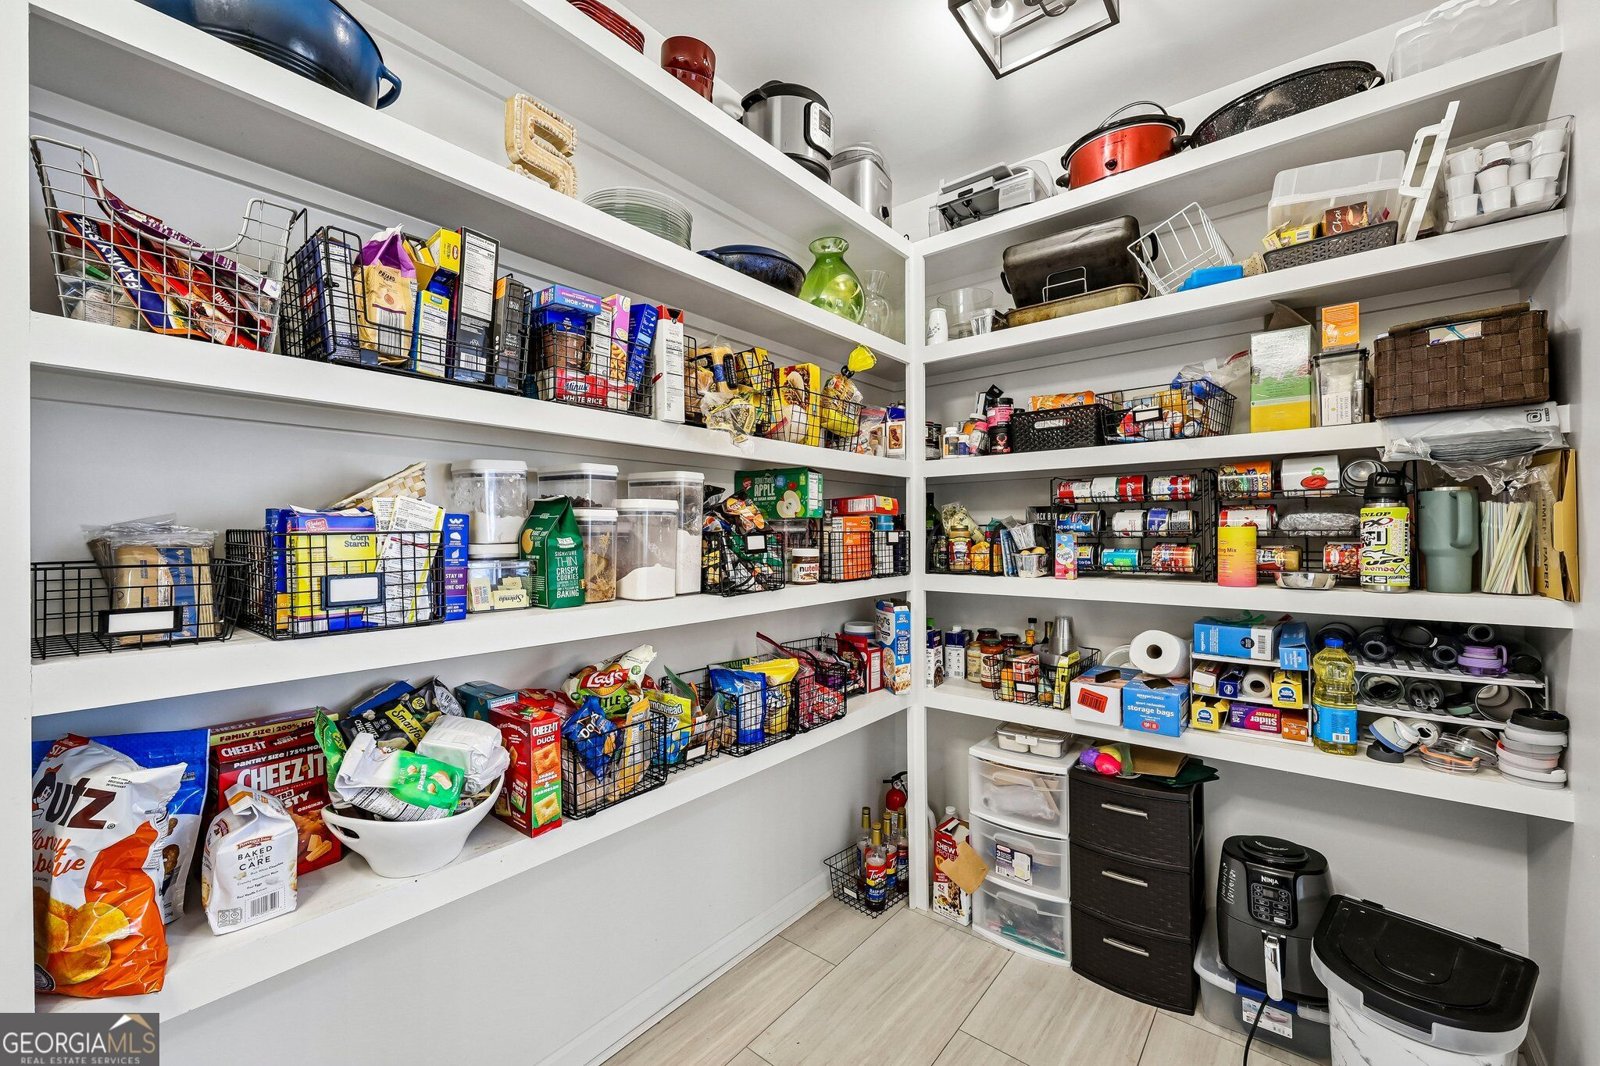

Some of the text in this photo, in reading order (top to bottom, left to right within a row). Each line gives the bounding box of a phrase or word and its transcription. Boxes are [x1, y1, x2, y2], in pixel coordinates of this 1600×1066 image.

[587, 396, 603, 405] RICE
[754, 483, 775, 497] APPLE
[555, 556, 578, 567] THIN
[556, 567, 579, 576] CRISPY
[498, 593, 524, 603] Splenda
[556, 589, 580, 599] BAKING
[586, 668, 624, 688] Lay's
[1127, 704, 1174, 717] storage bags
[301, 720, 315, 728] MO
[391, 709, 424, 741] Smartfo
[1250, 715, 1277, 726] Slider
[532, 721, 559, 737] CHEEZ-IT
[536, 734, 556, 746] DUOZ
[221, 740, 266, 757] CHEEZ-IT
[237, 753, 326, 791] CHEEZ-IT
[237, 845, 273, 861] BAKED
[936, 840, 956, 854] CHEW
[239, 855, 271, 871] CARE
[1260, 875, 1279, 885] NINJA
